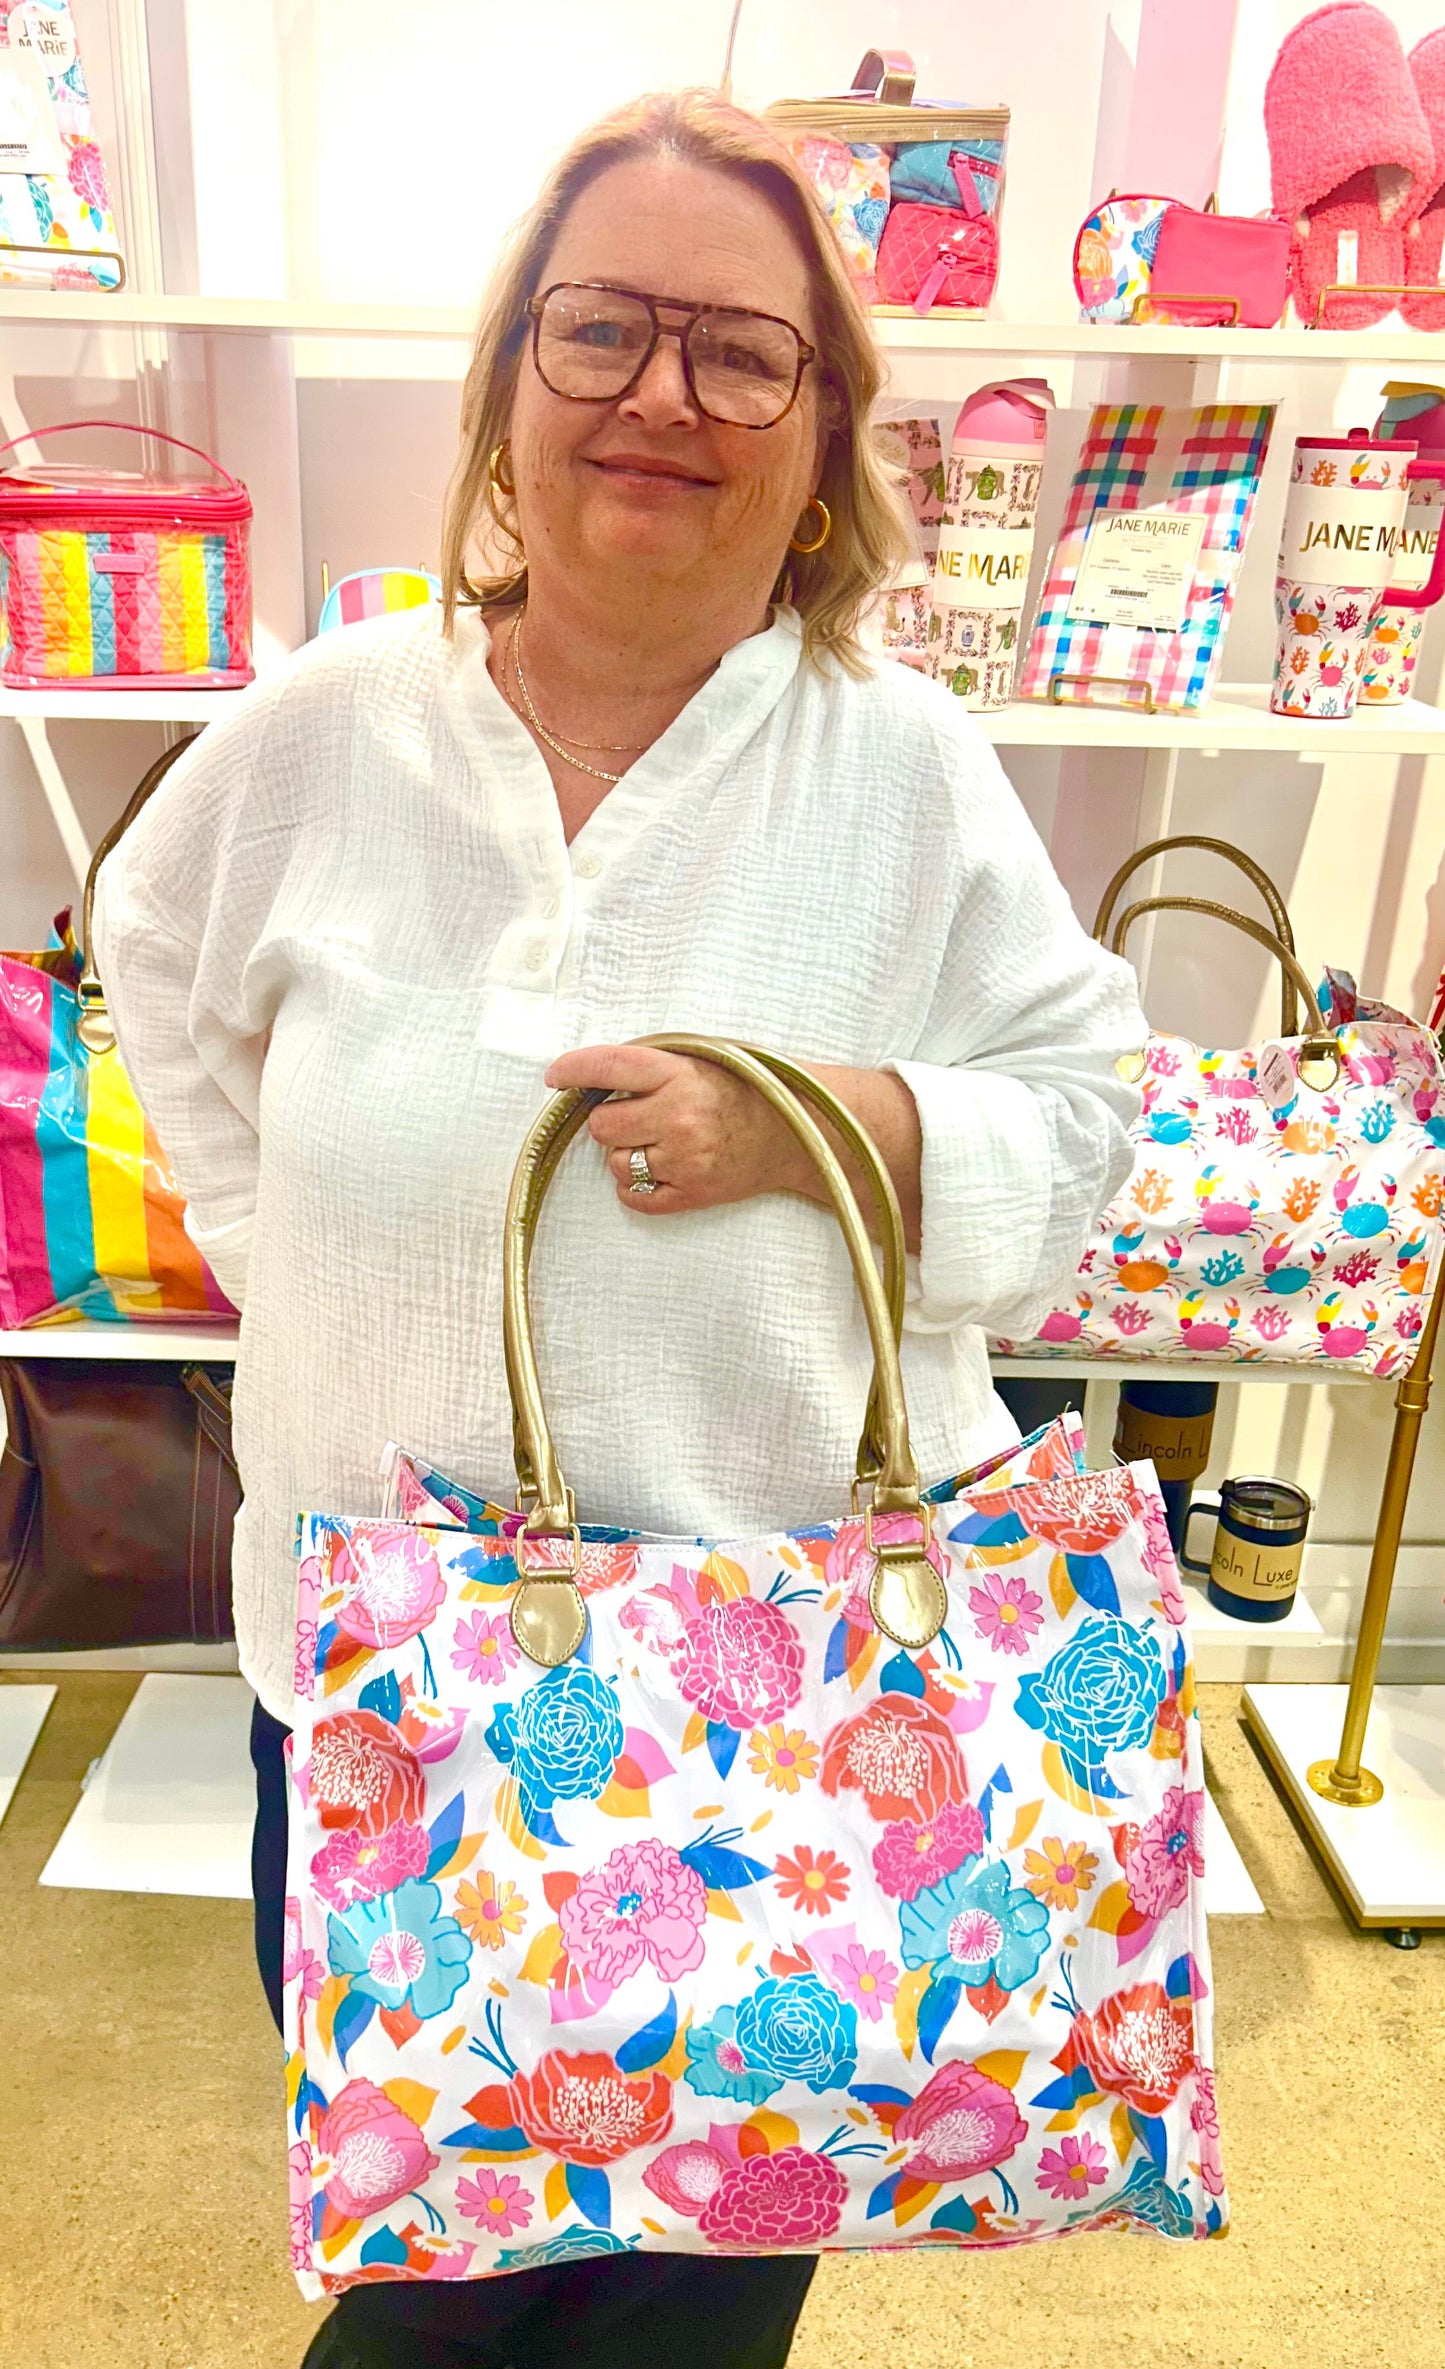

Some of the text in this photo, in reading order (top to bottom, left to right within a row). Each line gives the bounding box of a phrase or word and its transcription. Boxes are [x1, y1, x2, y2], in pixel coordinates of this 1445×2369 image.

[23, 19, 60, 37] JNE
[1106, 518, 1142, 533] JANE
[1299, 521, 1374, 553] JANE
[1120, 1417, 1192, 1459] Lincoln
[1252, 1554, 1293, 1587] Luxe
